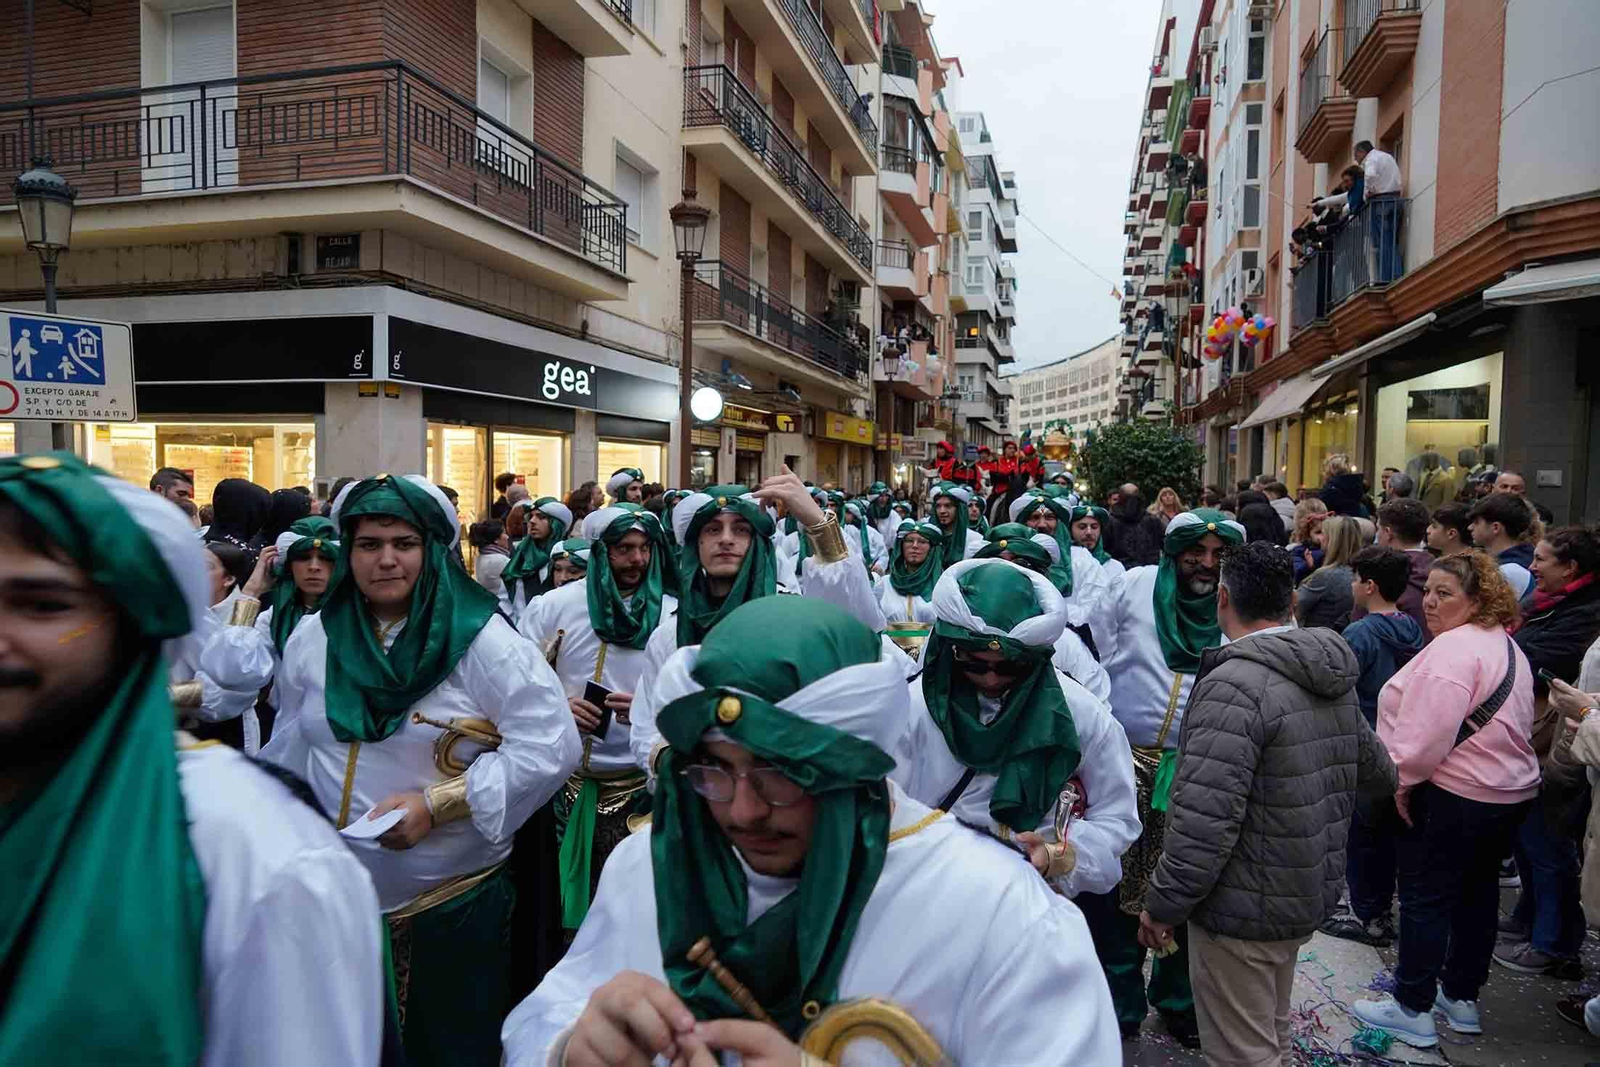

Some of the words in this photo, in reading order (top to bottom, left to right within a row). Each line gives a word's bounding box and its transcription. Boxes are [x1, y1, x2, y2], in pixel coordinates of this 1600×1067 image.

[24, 387, 64, 396] EXCEPTO
[68, 388, 100, 397] GARAJE
[56, 398, 72, 406] C/D
[76, 399, 87, 407] DE
[26, 408, 31, 416] 7
[45, 408, 54, 416] 10
[69, 409, 74, 417] Y
[78, 409, 89, 417] DE
[113, 410, 120, 418] 17
